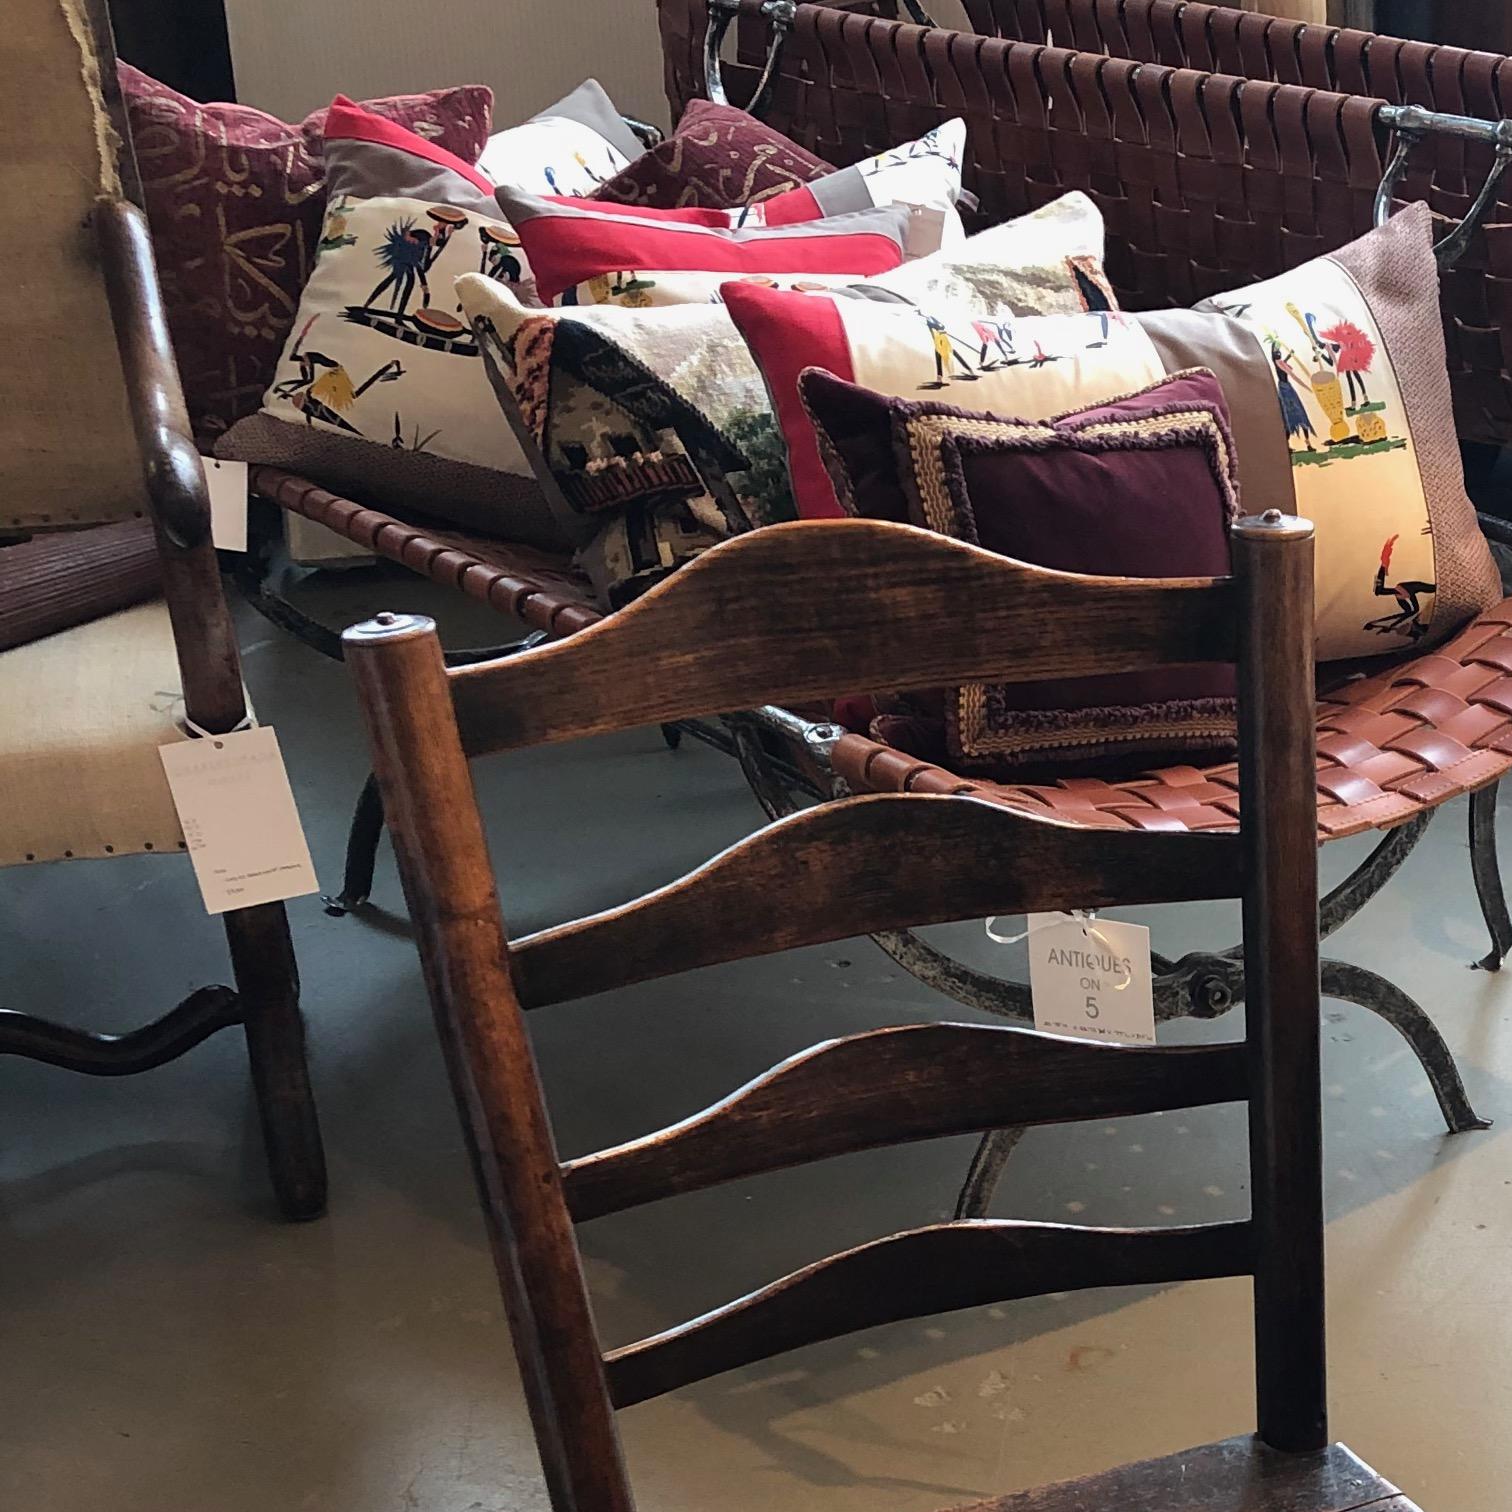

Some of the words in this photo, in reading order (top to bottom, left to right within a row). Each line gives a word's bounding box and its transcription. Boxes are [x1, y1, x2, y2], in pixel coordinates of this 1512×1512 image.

[1048, 948, 1132, 975] ANTIQUES
[1080, 977, 1101, 991] ON
[1085, 996, 1100, 1019] 5
